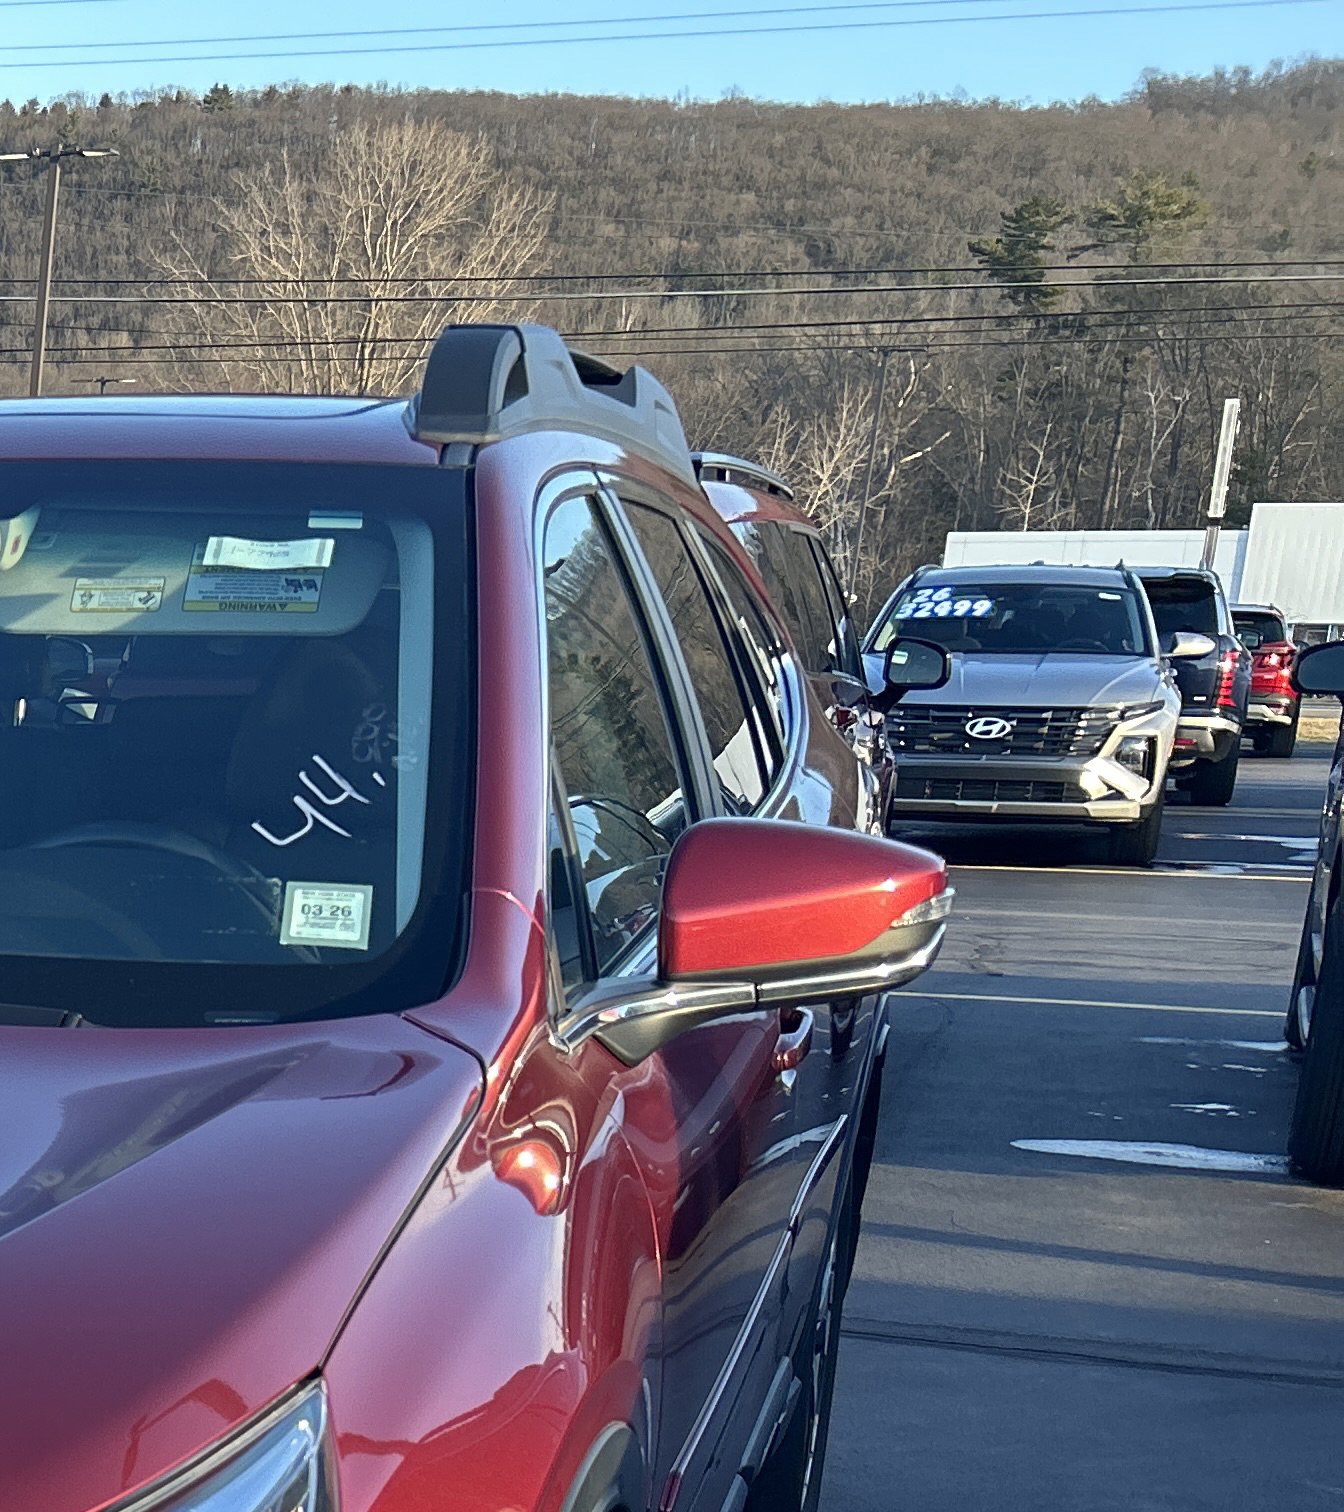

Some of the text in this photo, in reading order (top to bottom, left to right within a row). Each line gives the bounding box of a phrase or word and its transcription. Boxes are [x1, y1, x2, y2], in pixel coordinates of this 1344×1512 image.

[912, 587, 953, 604] 26
[895, 600, 993, 618] 32499
[300, 903, 354, 918] 03 26
